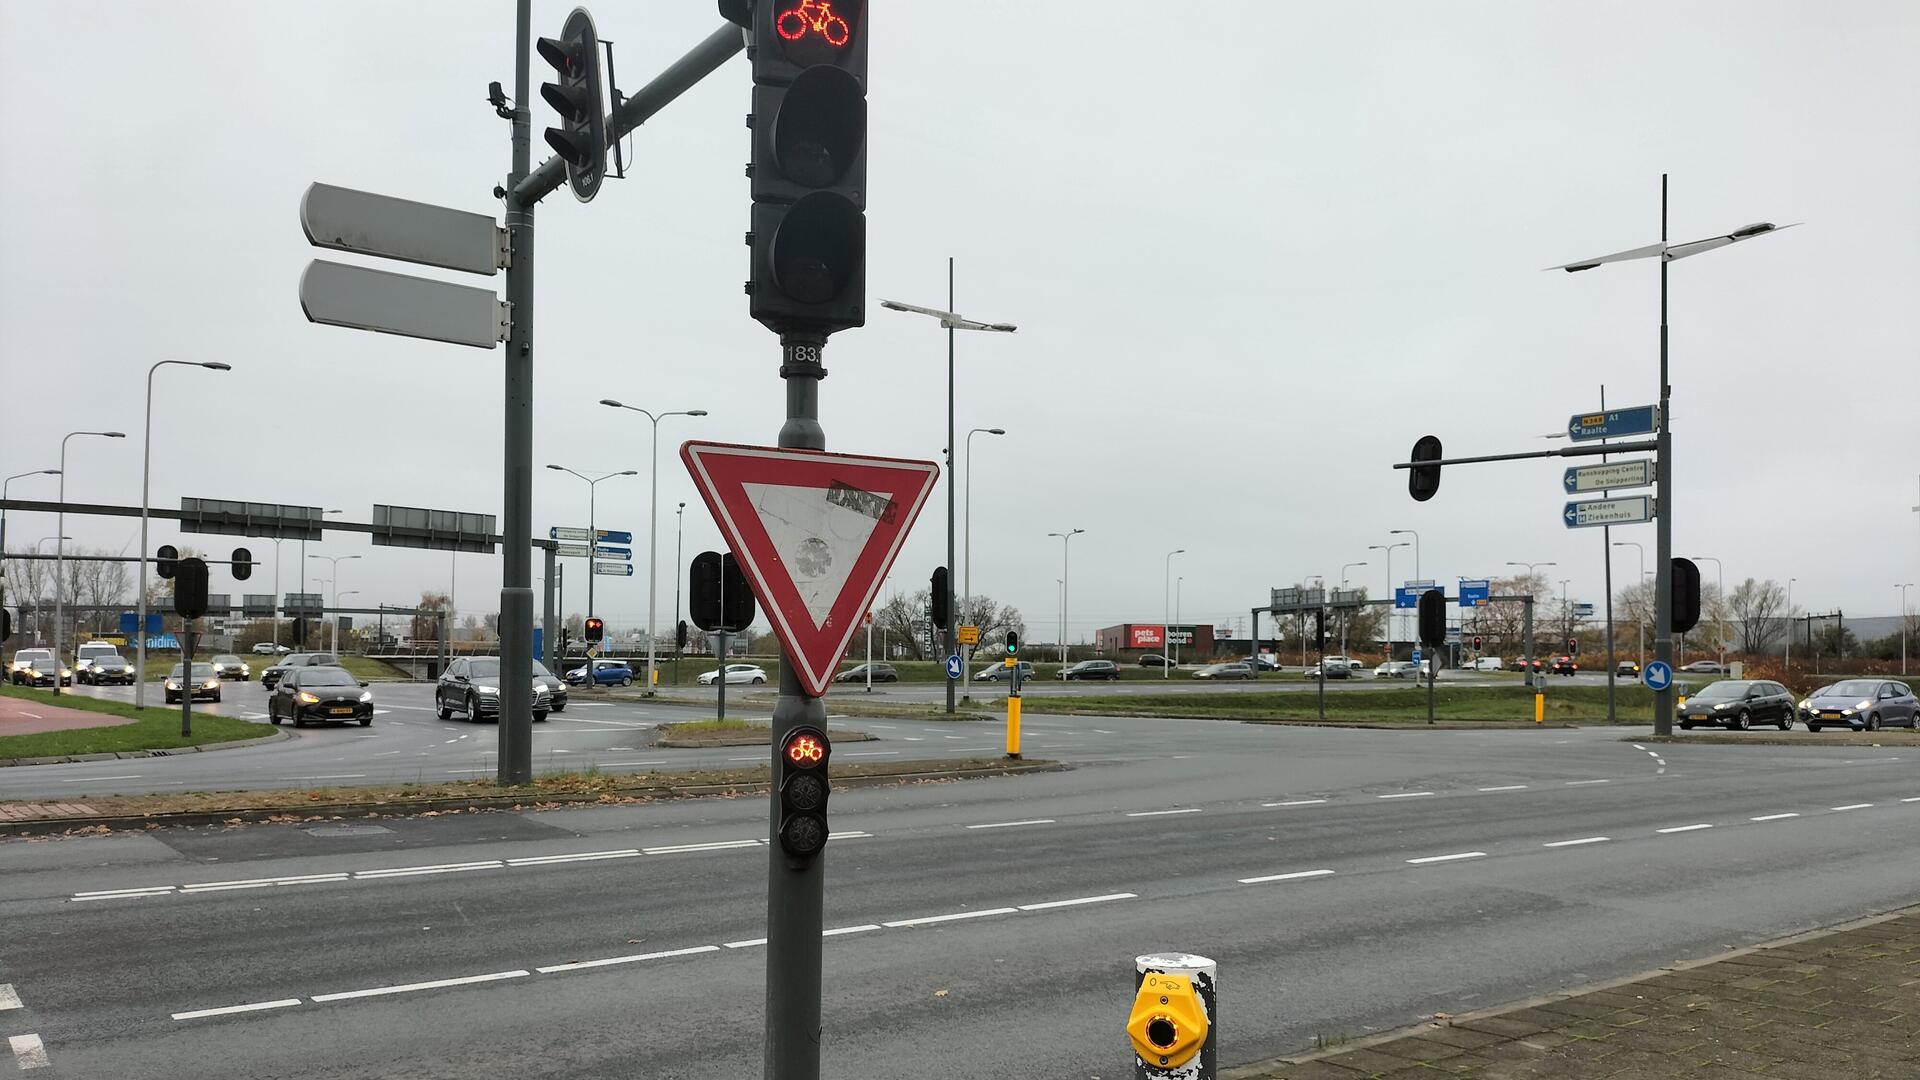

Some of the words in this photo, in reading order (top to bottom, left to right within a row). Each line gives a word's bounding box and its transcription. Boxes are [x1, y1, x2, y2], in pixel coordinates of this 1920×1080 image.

[1581, 426, 1608, 435] Raalte
[1587, 503, 1616, 511] Andere
[1588, 511, 1631, 521] Ziekenhuis
[1134, 629, 1154, 639] pets
[1137, 635, 1160, 644] place
